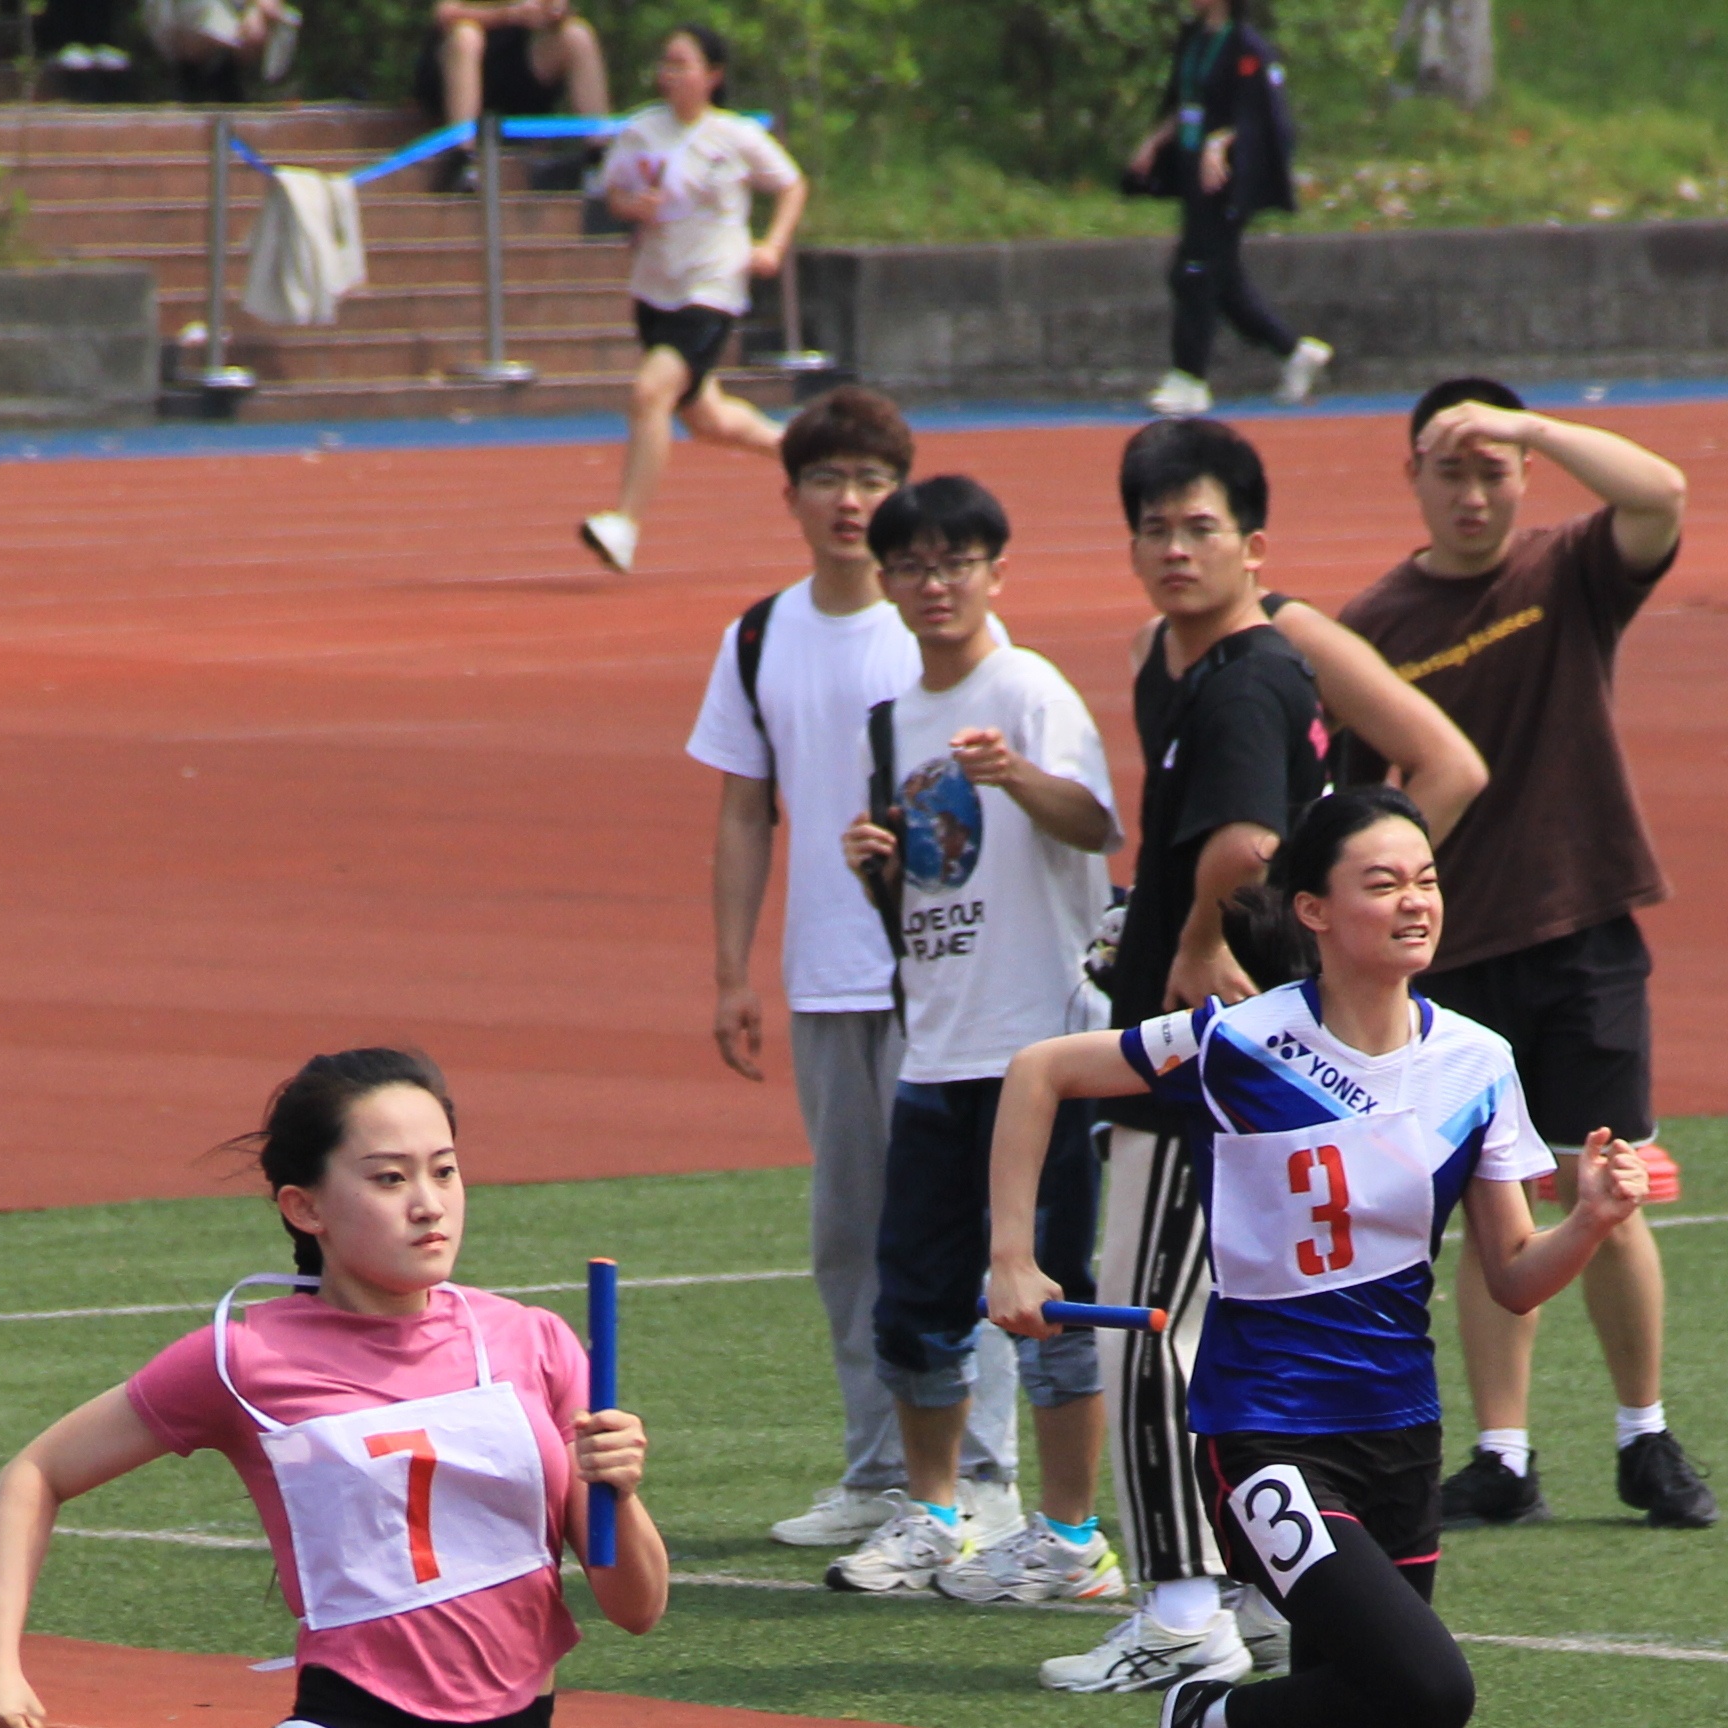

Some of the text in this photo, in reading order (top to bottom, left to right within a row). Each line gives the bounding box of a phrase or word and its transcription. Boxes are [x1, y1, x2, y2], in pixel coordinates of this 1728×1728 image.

[949, 900, 985, 926] OUR
[1308, 1055, 1379, 1115] YONEX
[1287, 1144, 1354, 1276] 3
[362, 1428, 441, 1584] 7
[1245, 1478, 1313, 1573] 3
